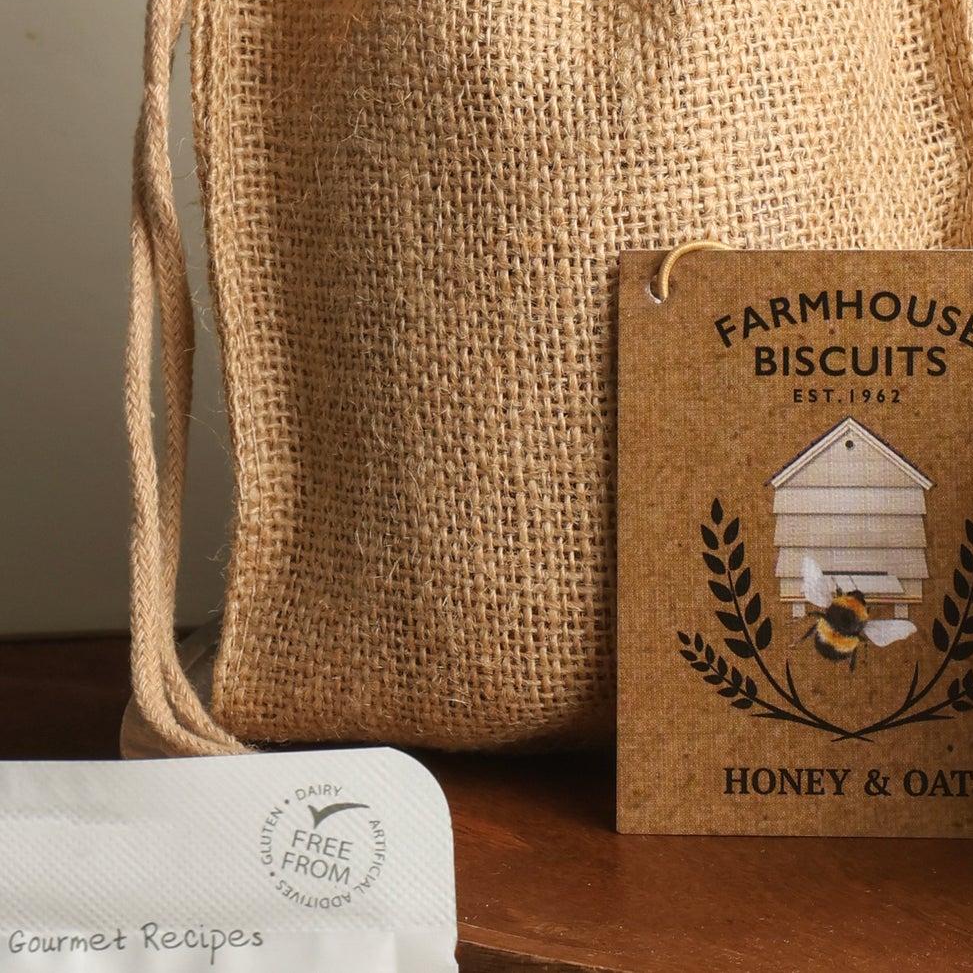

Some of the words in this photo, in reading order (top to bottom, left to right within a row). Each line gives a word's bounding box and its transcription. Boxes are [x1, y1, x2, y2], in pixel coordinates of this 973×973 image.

[754, 345, 947, 377] BISCUITS
[295, 784, 342, 801] DAIRY
[723, 767, 852, 796] HONEY
[863, 769, 892, 797] &
[260, 806, 284, 865] GLUTEN
[291, 829, 354, 861] FREE
[281, 851, 351, 886] FROM
[354, 819, 387, 895] ARTIFICIAL
[275, 879, 352, 909] ADDITIVES
[8, 929, 126, 953] Gourmet
[142, 922, 264, 965] Recipes
